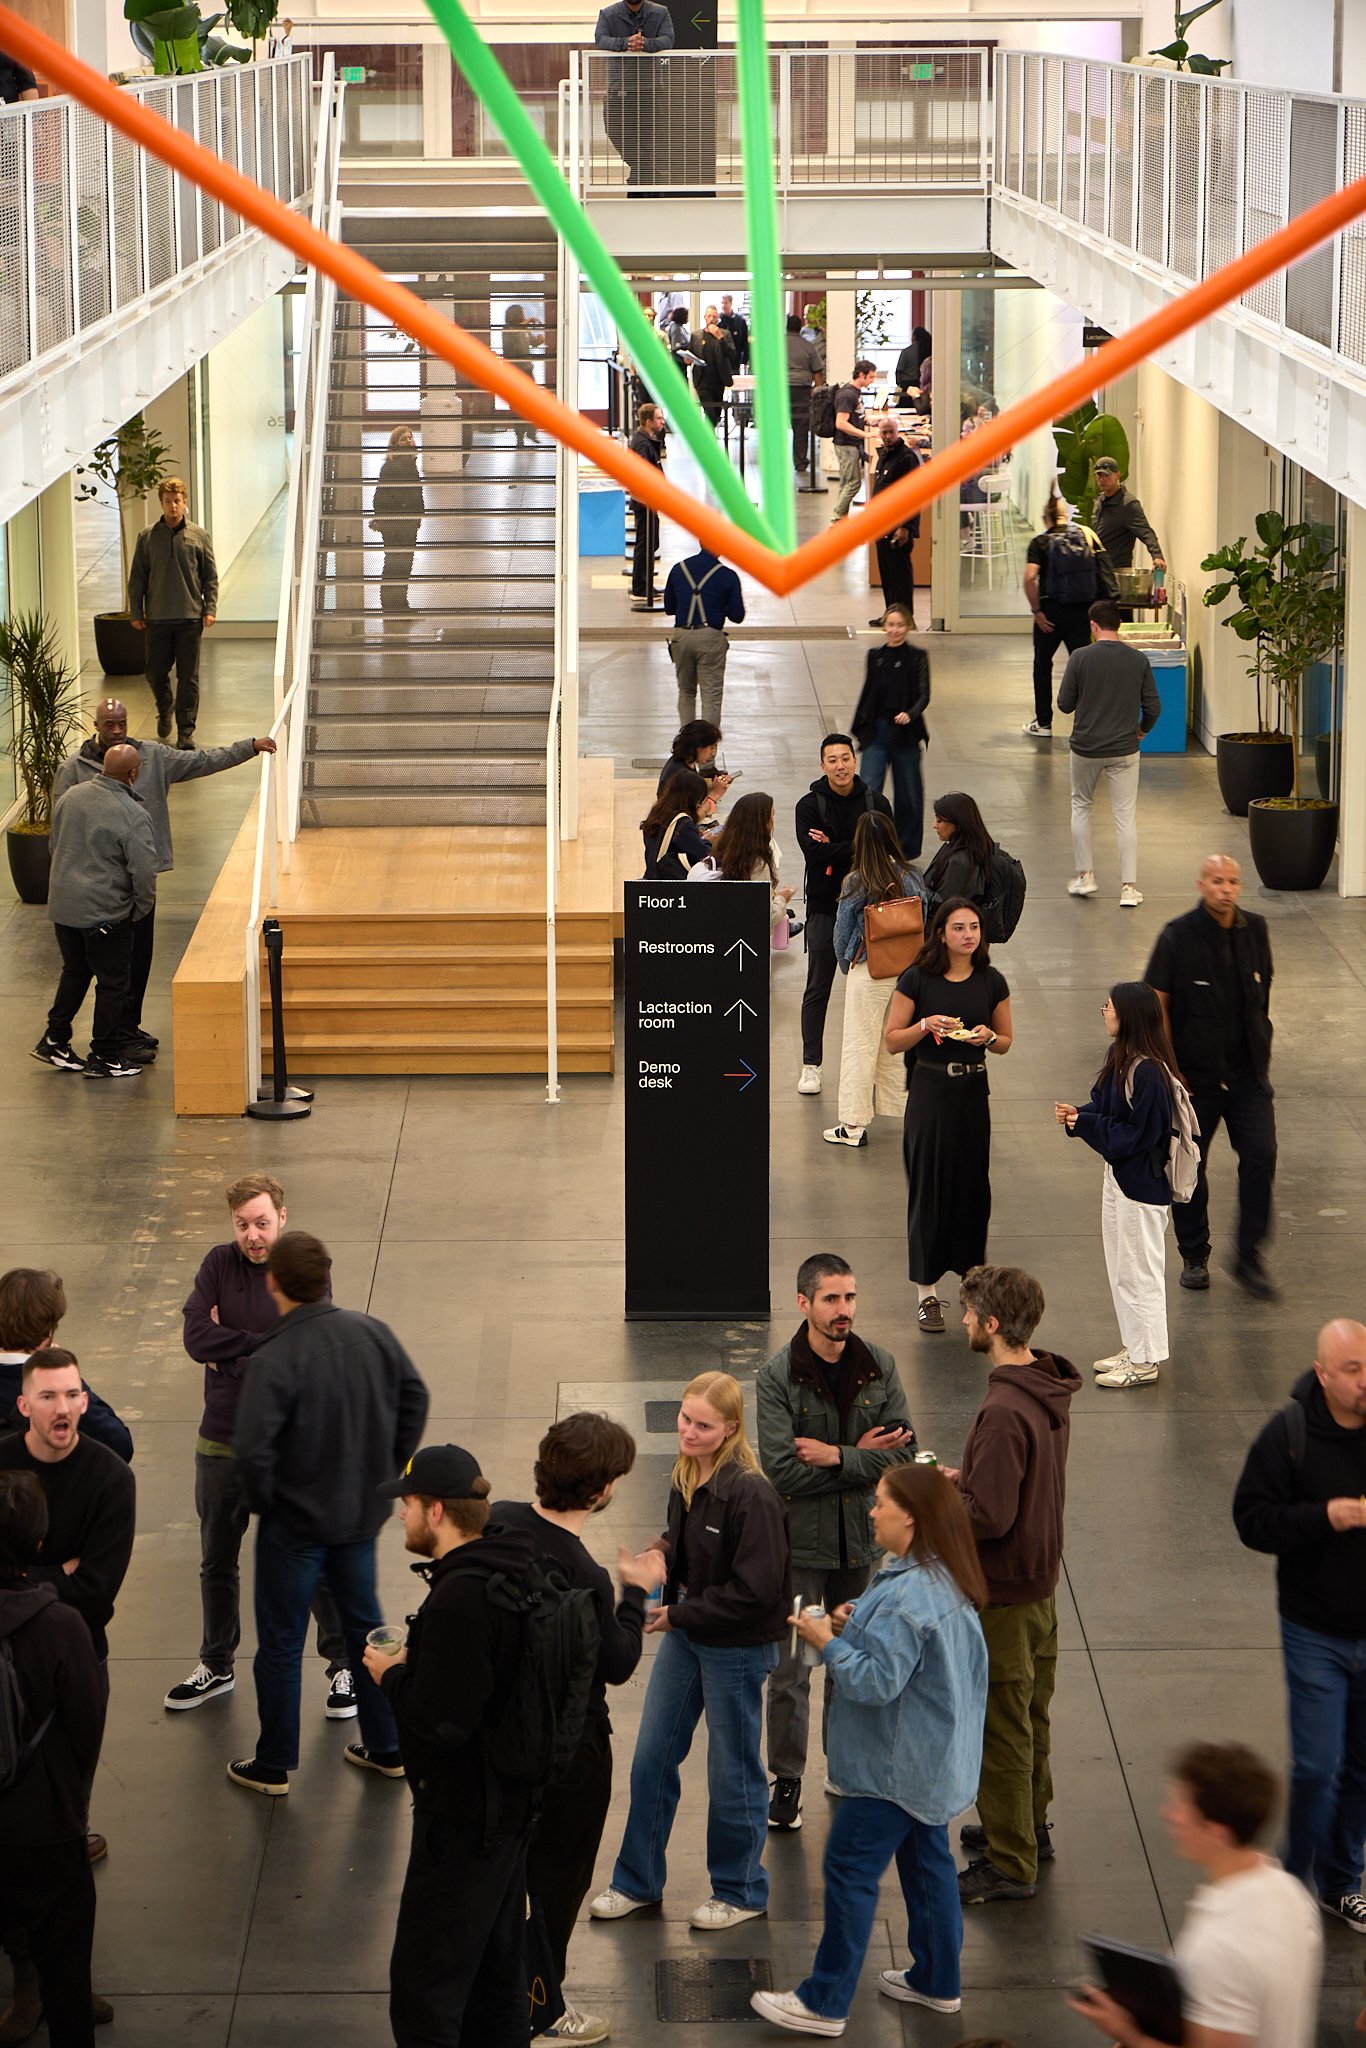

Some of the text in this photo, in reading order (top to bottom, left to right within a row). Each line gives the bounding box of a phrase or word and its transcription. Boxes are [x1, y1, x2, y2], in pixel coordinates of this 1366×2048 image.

[639, 896, 686, 908] Floor 1
[639, 941, 714, 953] Restrooms
[639, 1001, 712, 1013] Lactaction
[639, 1019, 674, 1028] room
[639, 1061, 680, 1073] Demo
[639, 1076, 672, 1088] desk
